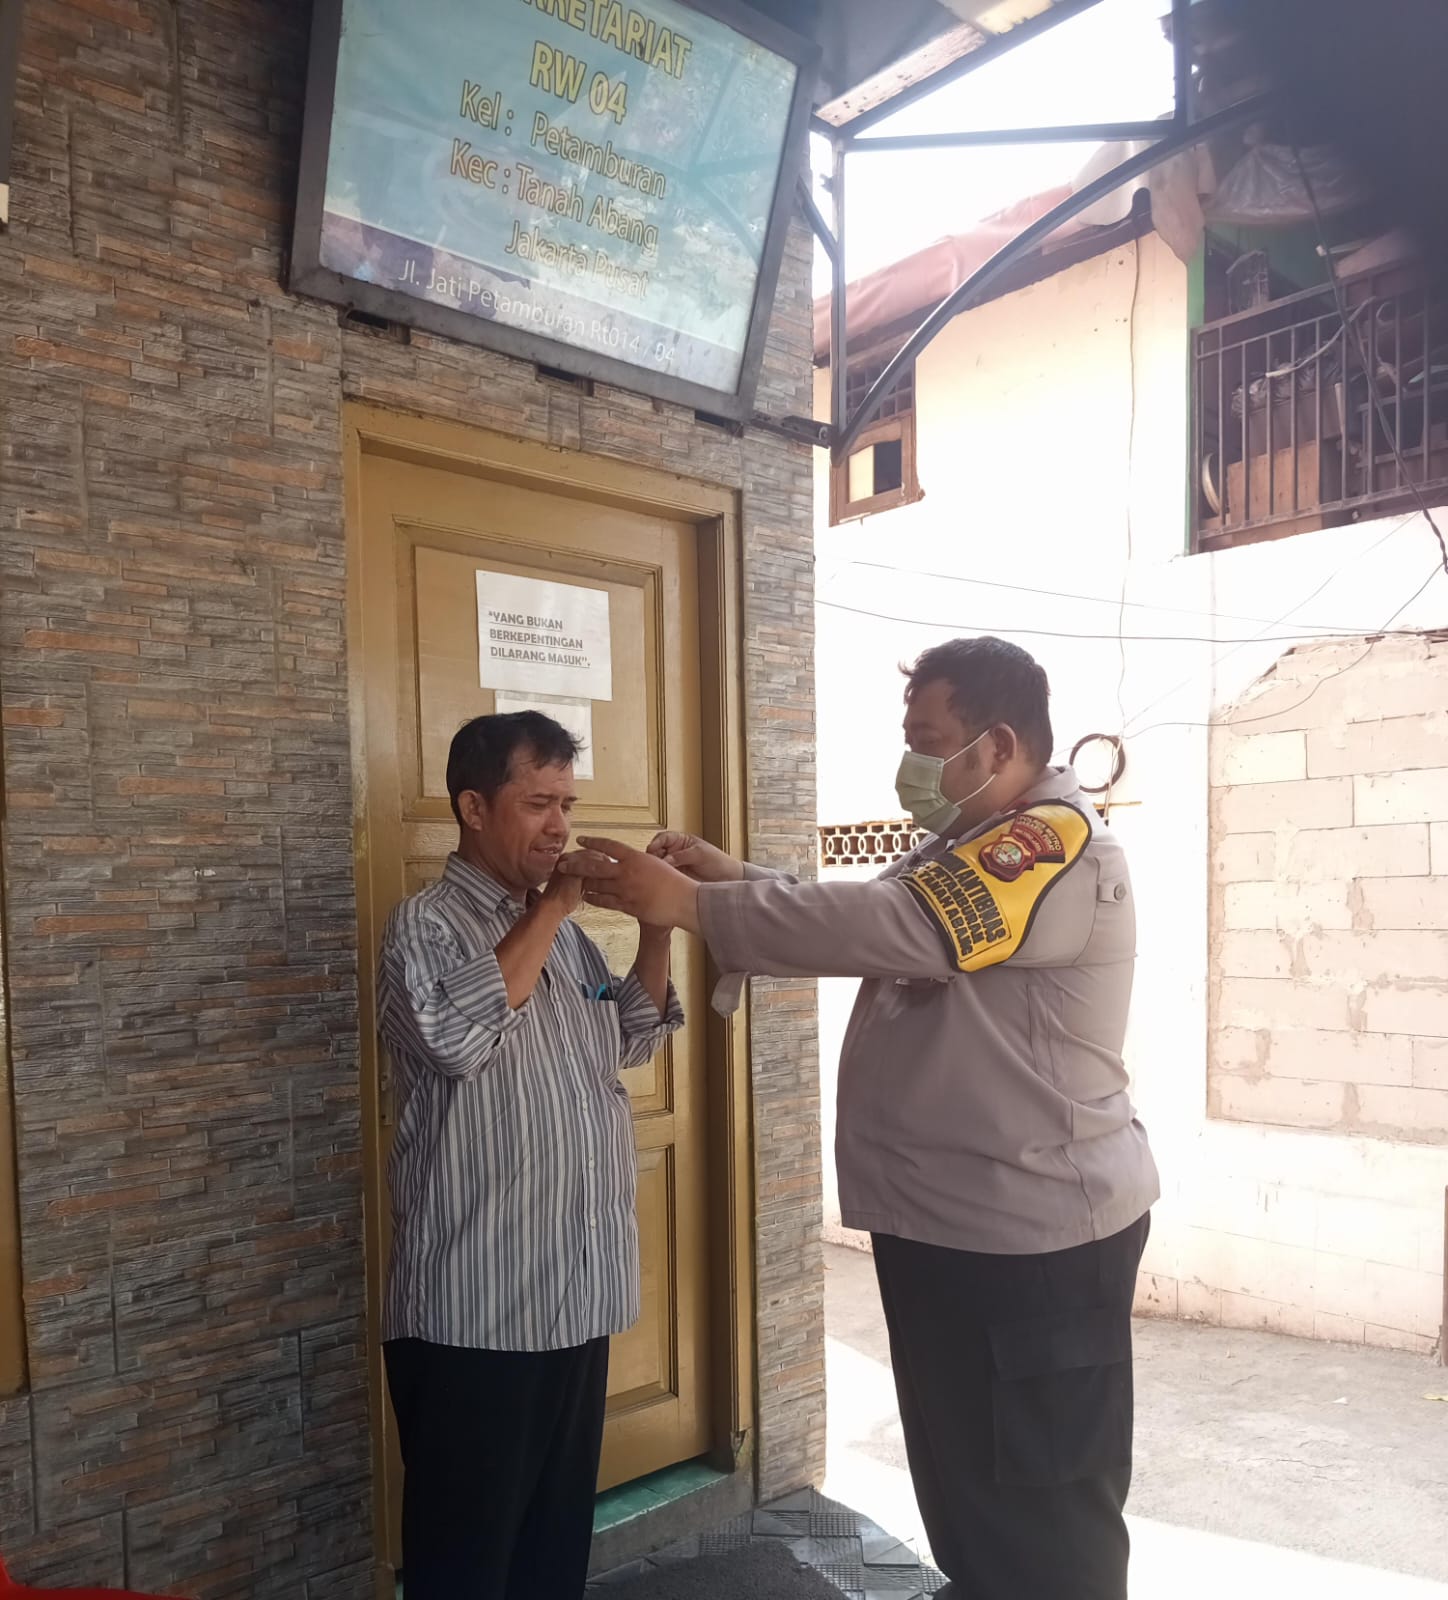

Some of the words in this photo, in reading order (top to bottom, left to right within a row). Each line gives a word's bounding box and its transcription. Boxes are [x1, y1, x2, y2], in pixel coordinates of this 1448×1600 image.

[529, 40, 587, 104] RW
[589, 71, 628, 125] 04
[531, 111, 666, 200] Petamburan
[516, 163, 584, 222] Tanah
[587, 195, 659, 257] Abang
[505, 220, 588, 275] Jakarta
[593, 250, 650, 299] Pusat
[398, 260, 420, 286] Jl.
[426, 268, 462, 298] Jati
[468, 280, 585, 337] Petamburan
[489, 628, 583, 649] BERKEPENTINGAN
[490, 646, 546, 662] DILARANG
[527, 615, 563, 630] BUKAN
[917, 870, 954, 912] TANAH
